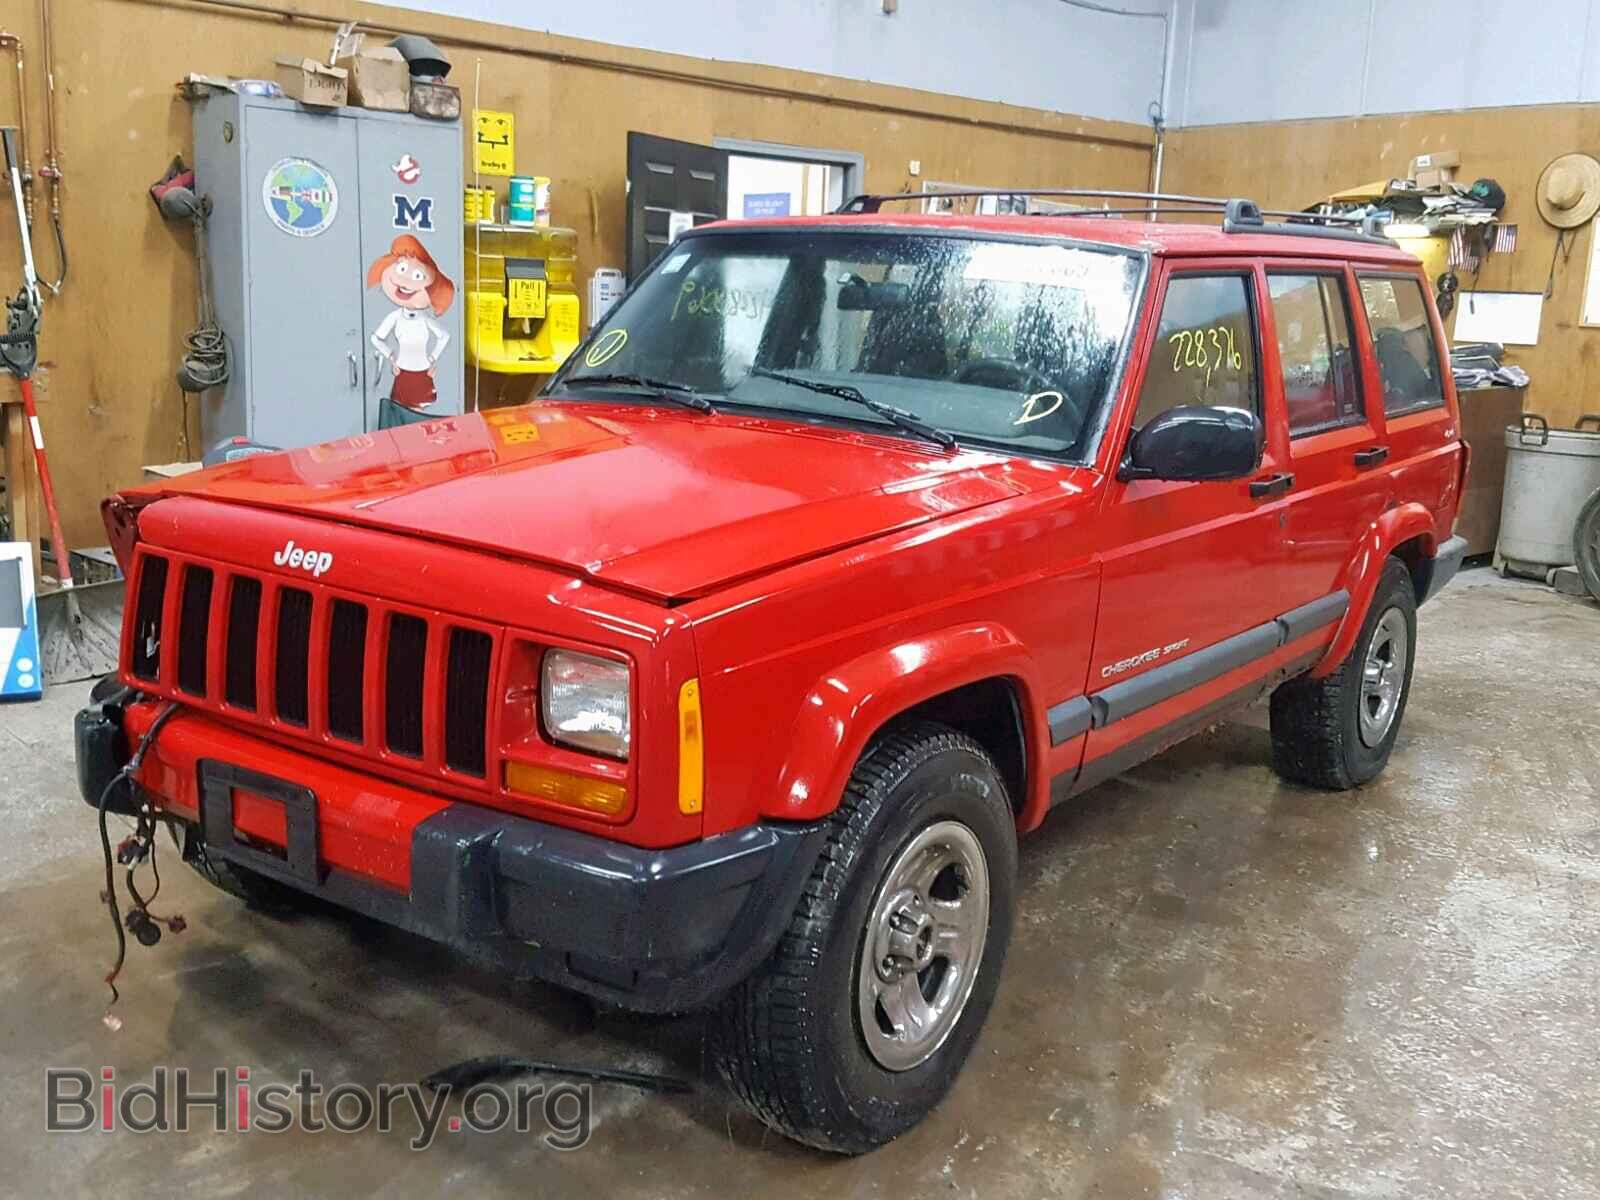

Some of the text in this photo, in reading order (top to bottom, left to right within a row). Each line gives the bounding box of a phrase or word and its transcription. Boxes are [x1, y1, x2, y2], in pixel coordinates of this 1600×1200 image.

[393, 195, 433, 229] M
[1014, 391, 1064, 425] D
[273, 540, 333, 577] Jeep
[1102, 647, 1161, 677] CHEROKEE
